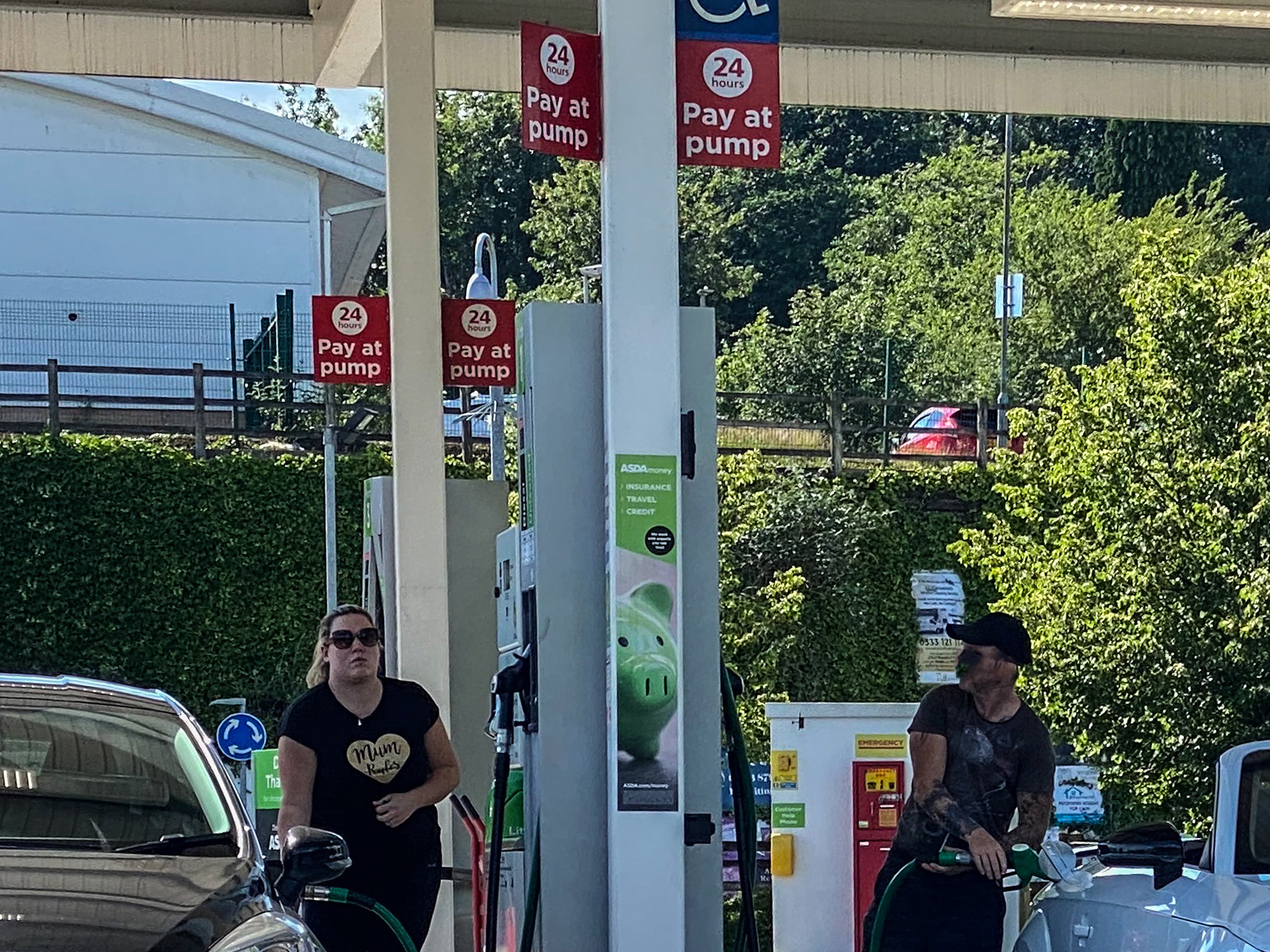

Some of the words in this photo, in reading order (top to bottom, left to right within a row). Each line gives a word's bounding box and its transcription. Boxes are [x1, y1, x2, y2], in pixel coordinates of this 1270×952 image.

[547, 43, 569, 65] 24
[546, 65, 570, 77] hours
[713, 57, 744, 77] 24
[711, 77, 744, 89] hours
[526, 86, 563, 118] Pay
[569, 97, 590, 119] at
[683, 102, 736, 130] Pay
[744, 106, 772, 128] at
[529, 119, 588, 150] pump
[686, 135, 770, 160] pump
[339, 307, 362, 321] 24
[468, 309, 491, 325] 24
[338, 321, 362, 330] hours
[467, 324, 491, 332] hours
[318, 338, 355, 359] Pay
[361, 340, 383, 356] at
[448, 342, 485, 361] Pay
[491, 343, 511, 359] at
[320, 361, 381, 378] pump
[450, 364, 511, 381] pump
[620, 464, 672, 475] ASDAmoney
[626, 483, 672, 491] INSURANCE
[626, 495, 657, 503] TRAVEL
[626, 508, 656, 516] CREDIT
[352, 741, 401, 764] Mum
[265, 775, 281, 789] Tha
[509, 826, 524, 835] Lit
[269, 834, 280, 851] AS
